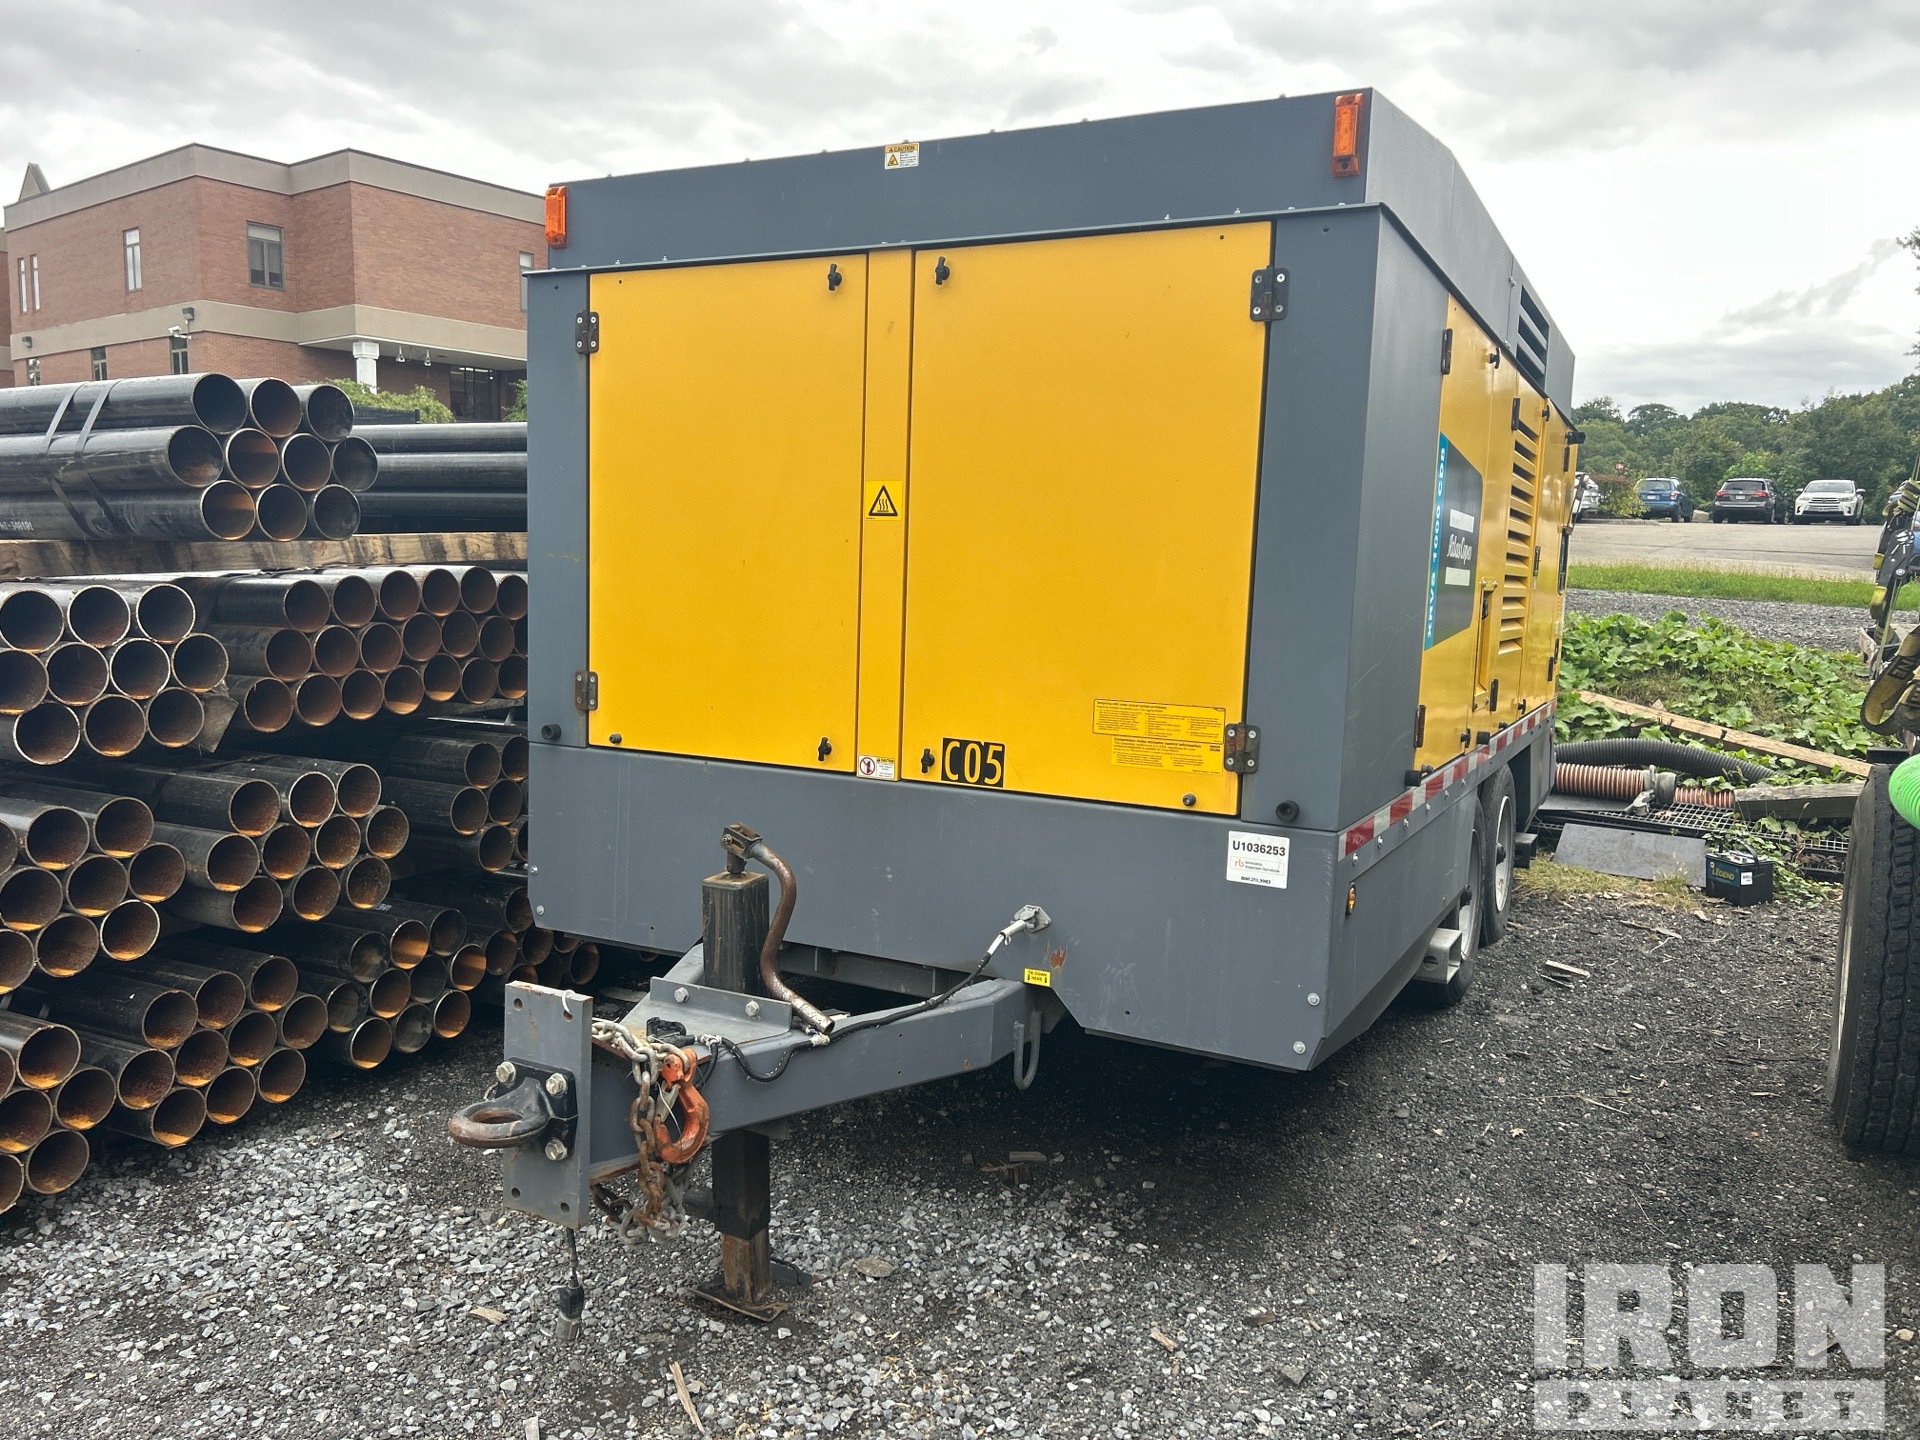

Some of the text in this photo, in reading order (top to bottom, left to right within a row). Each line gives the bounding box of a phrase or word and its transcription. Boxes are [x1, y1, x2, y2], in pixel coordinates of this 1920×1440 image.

[1432, 505, 1441, 563] 1000
[945, 740, 1003, 785] C05
[1232, 840, 1286, 856] U1036253
[1712, 867, 1735, 880] LEGEND
